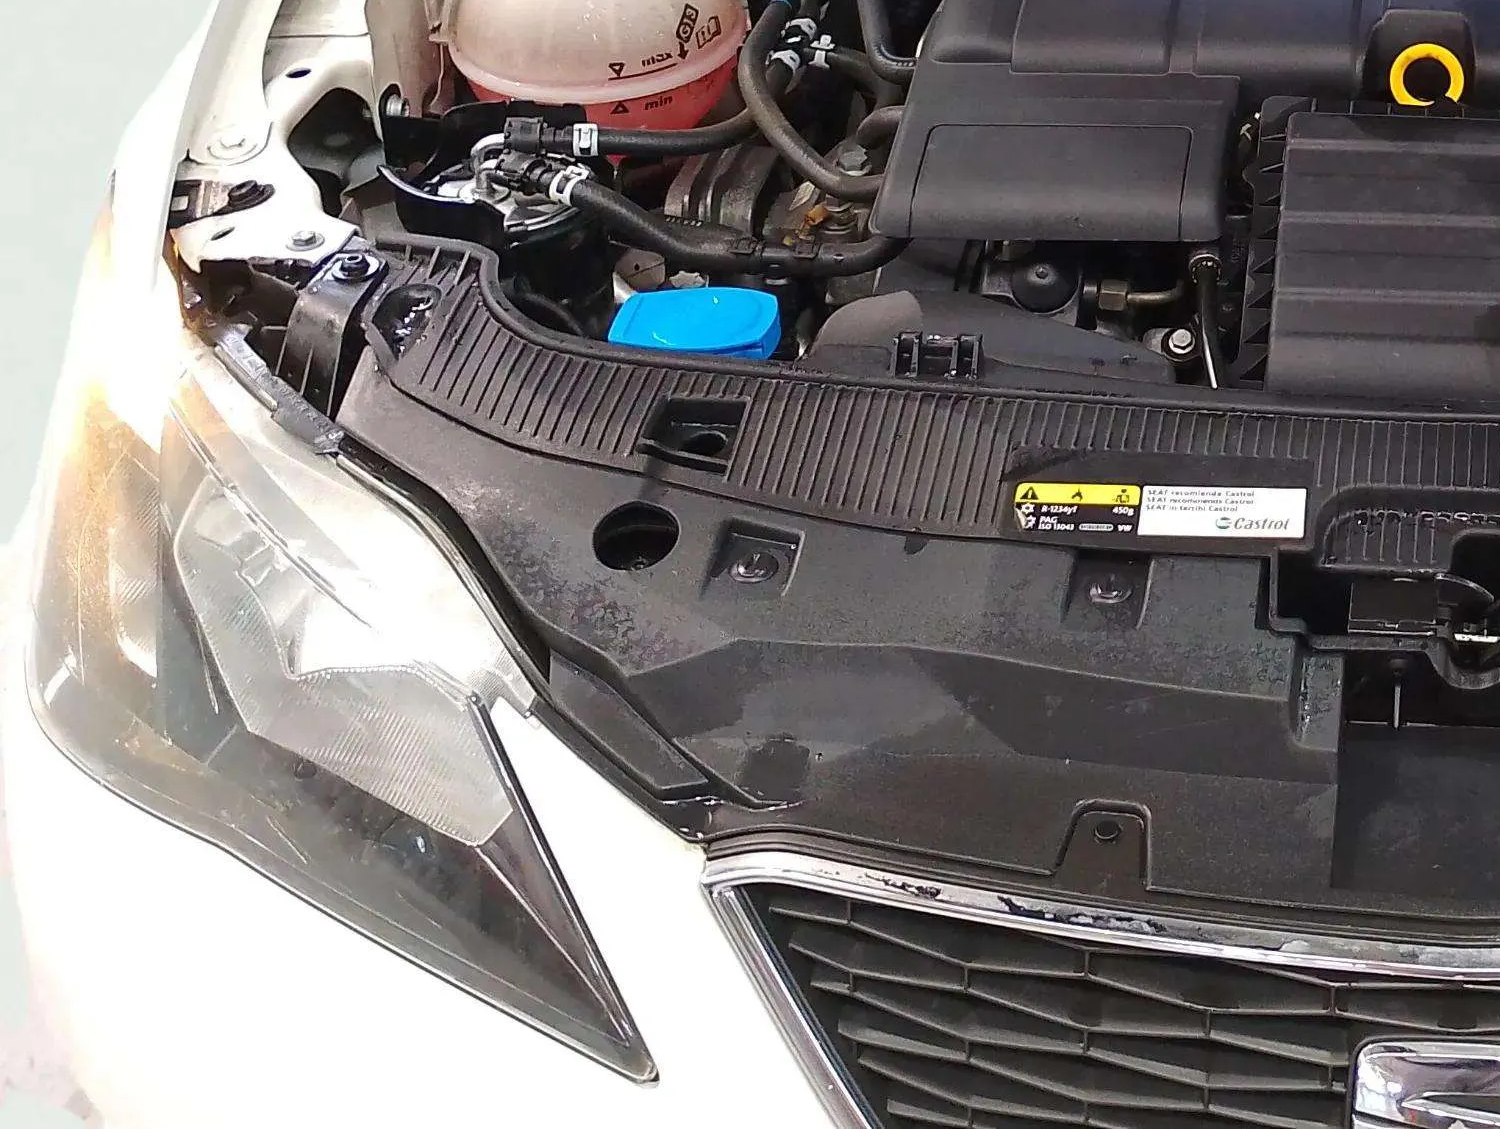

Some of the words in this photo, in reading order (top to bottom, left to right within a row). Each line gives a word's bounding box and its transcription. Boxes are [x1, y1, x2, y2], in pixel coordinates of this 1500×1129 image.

[641, 52, 673, 68] max
[644, 95, 673, 111] min
[1041, 505, 1078, 515] R-1234yf
[1112, 506, 1134, 516] 450g
[1233, 517, 1290, 530] Castrol
